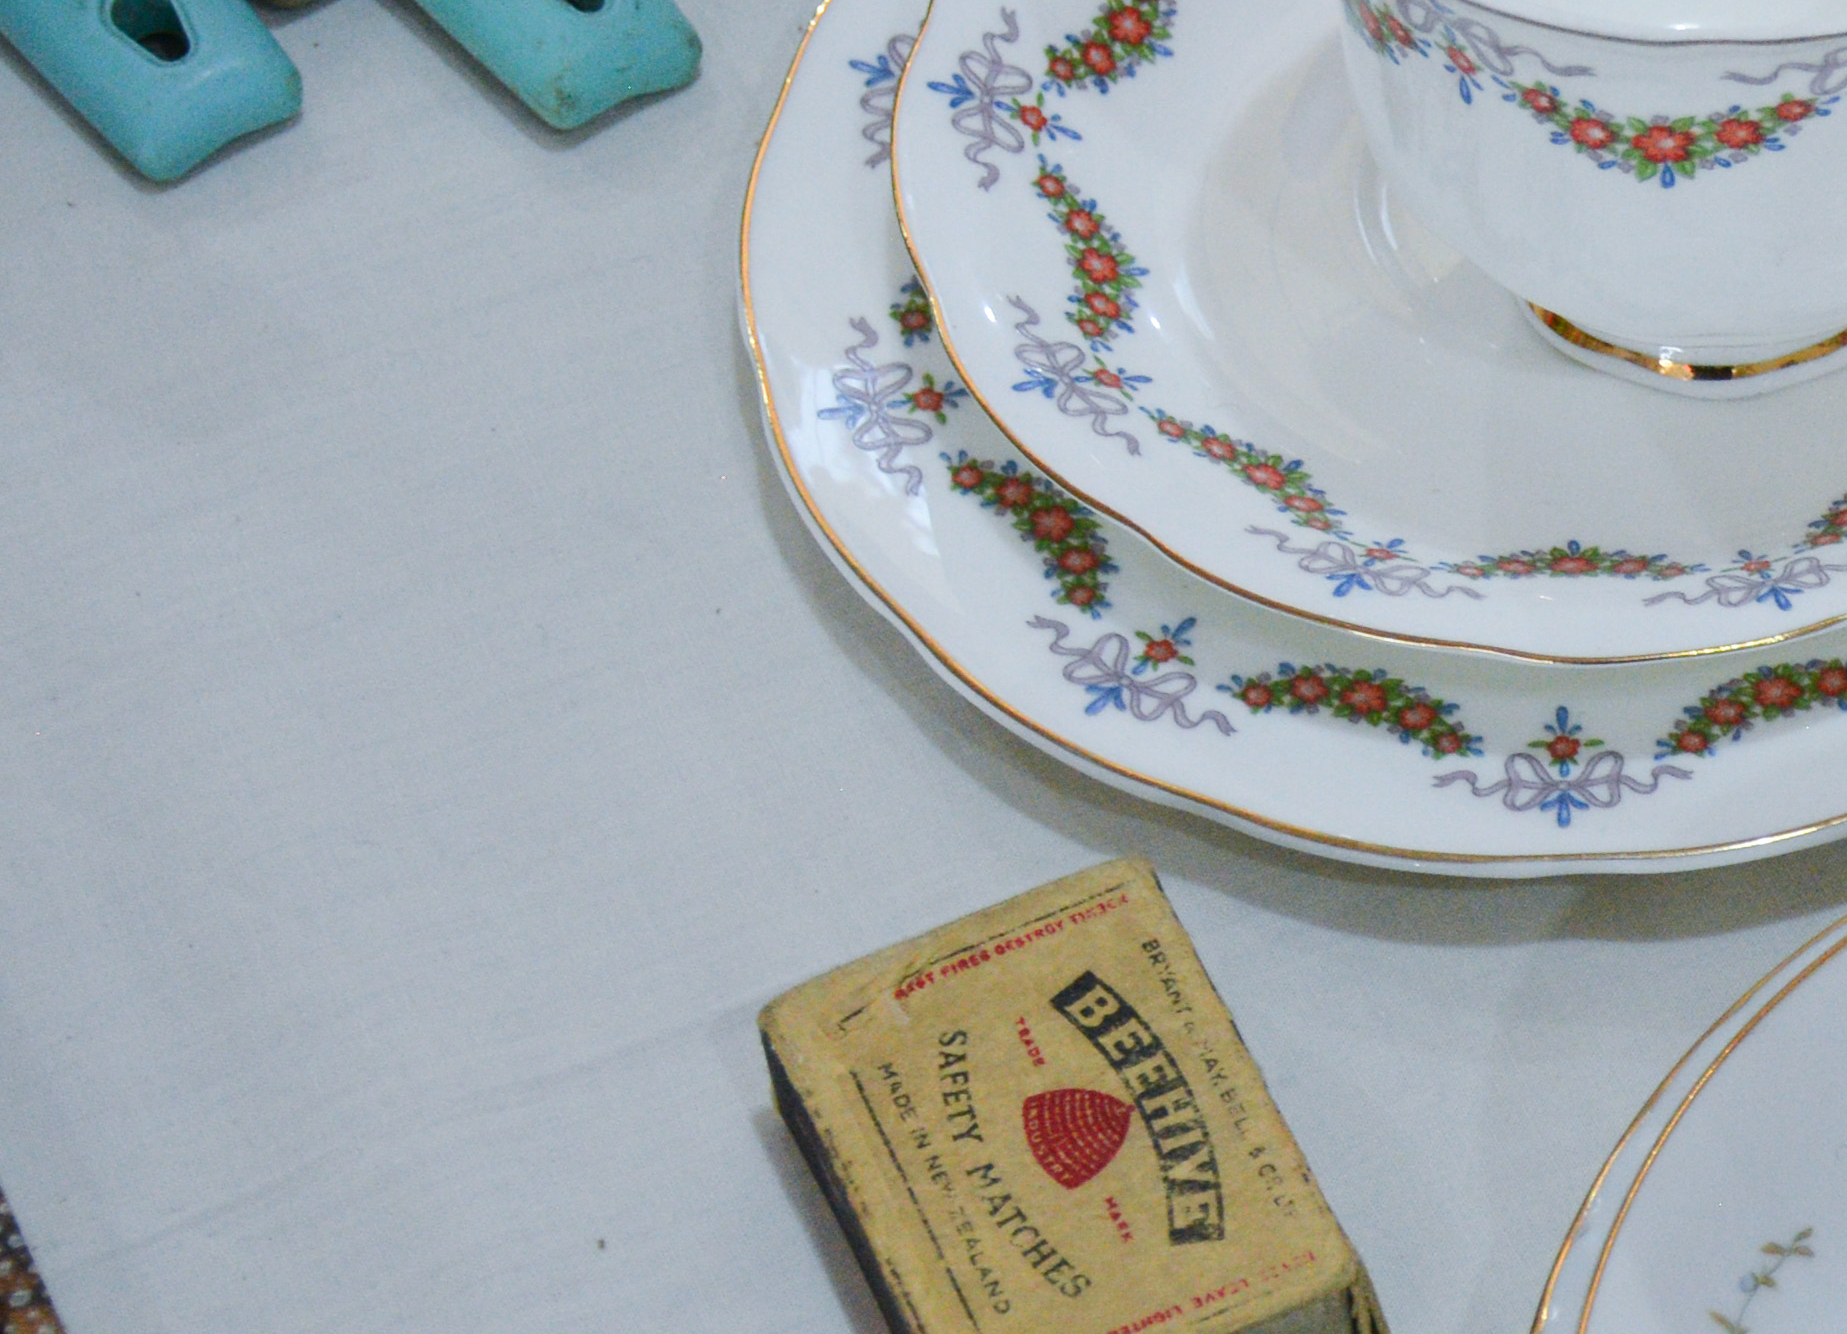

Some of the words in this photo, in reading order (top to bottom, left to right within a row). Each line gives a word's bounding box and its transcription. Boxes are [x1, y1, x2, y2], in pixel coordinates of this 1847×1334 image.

[940, 949, 991, 978] FIRES
[994, 919, 1065, 956] DESTROY
[1015, 1016, 1046, 1067] TRADE
[878, 1061, 918, 1122] MADE
[909, 1126, 932, 1150] IN
[1060, 979, 1219, 1230] BEEHIVE
[1219, 1087, 1250, 1141] BEL
[938, 1029, 985, 1144] SAFETY
[965, 1162, 1093, 1299] MATCHES
[1028, 1100, 1076, 1183] INDUSTRY
[1104, 1195, 1135, 1244] MARK
